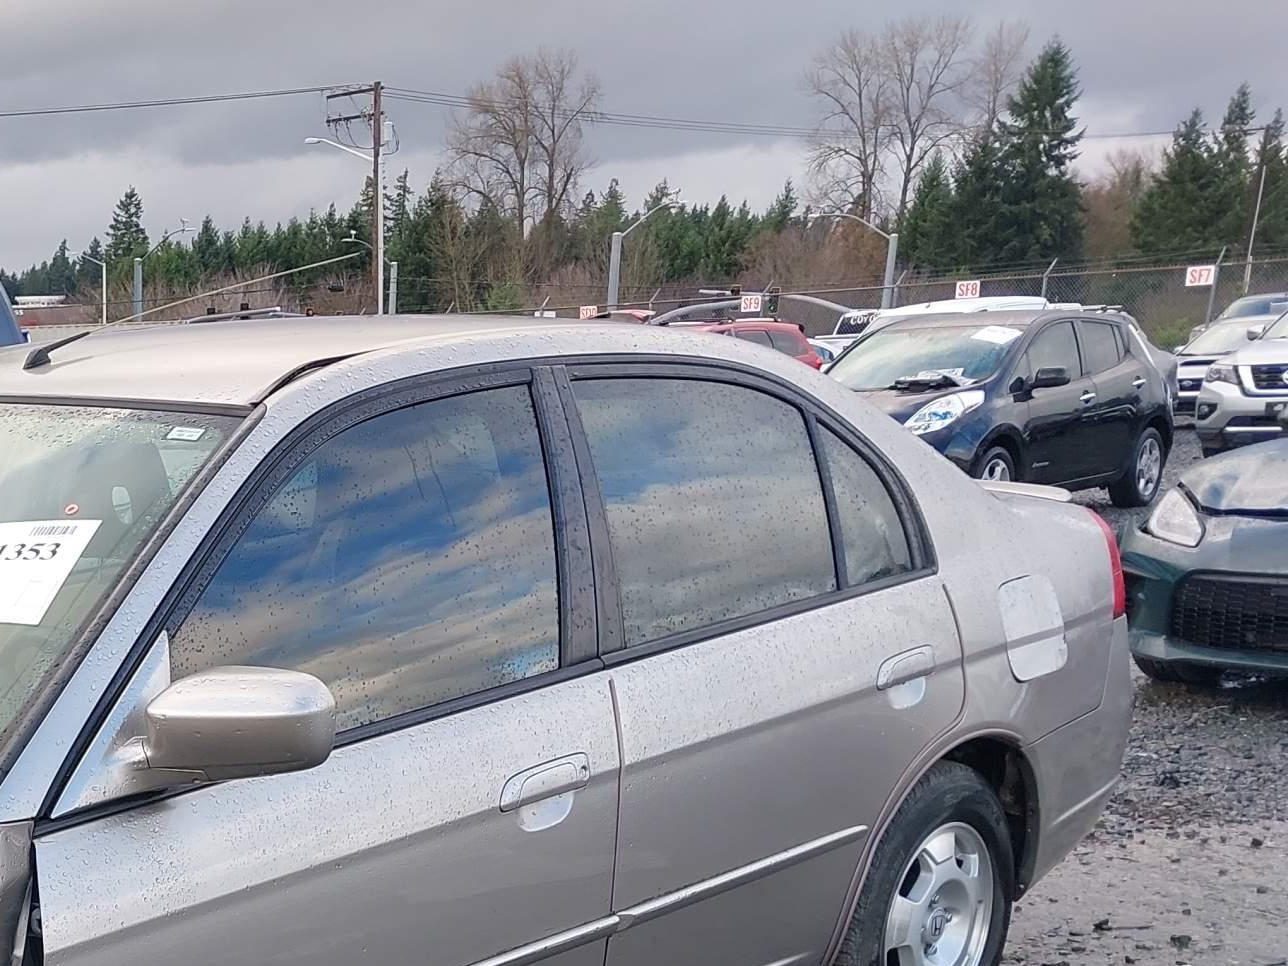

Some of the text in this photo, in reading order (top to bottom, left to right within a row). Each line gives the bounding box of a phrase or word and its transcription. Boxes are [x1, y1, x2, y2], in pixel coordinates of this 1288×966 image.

[1190, 269, 1212, 284] SF7
[958, 283, 978, 297] SF8
[742, 298, 761, 311] SF9
